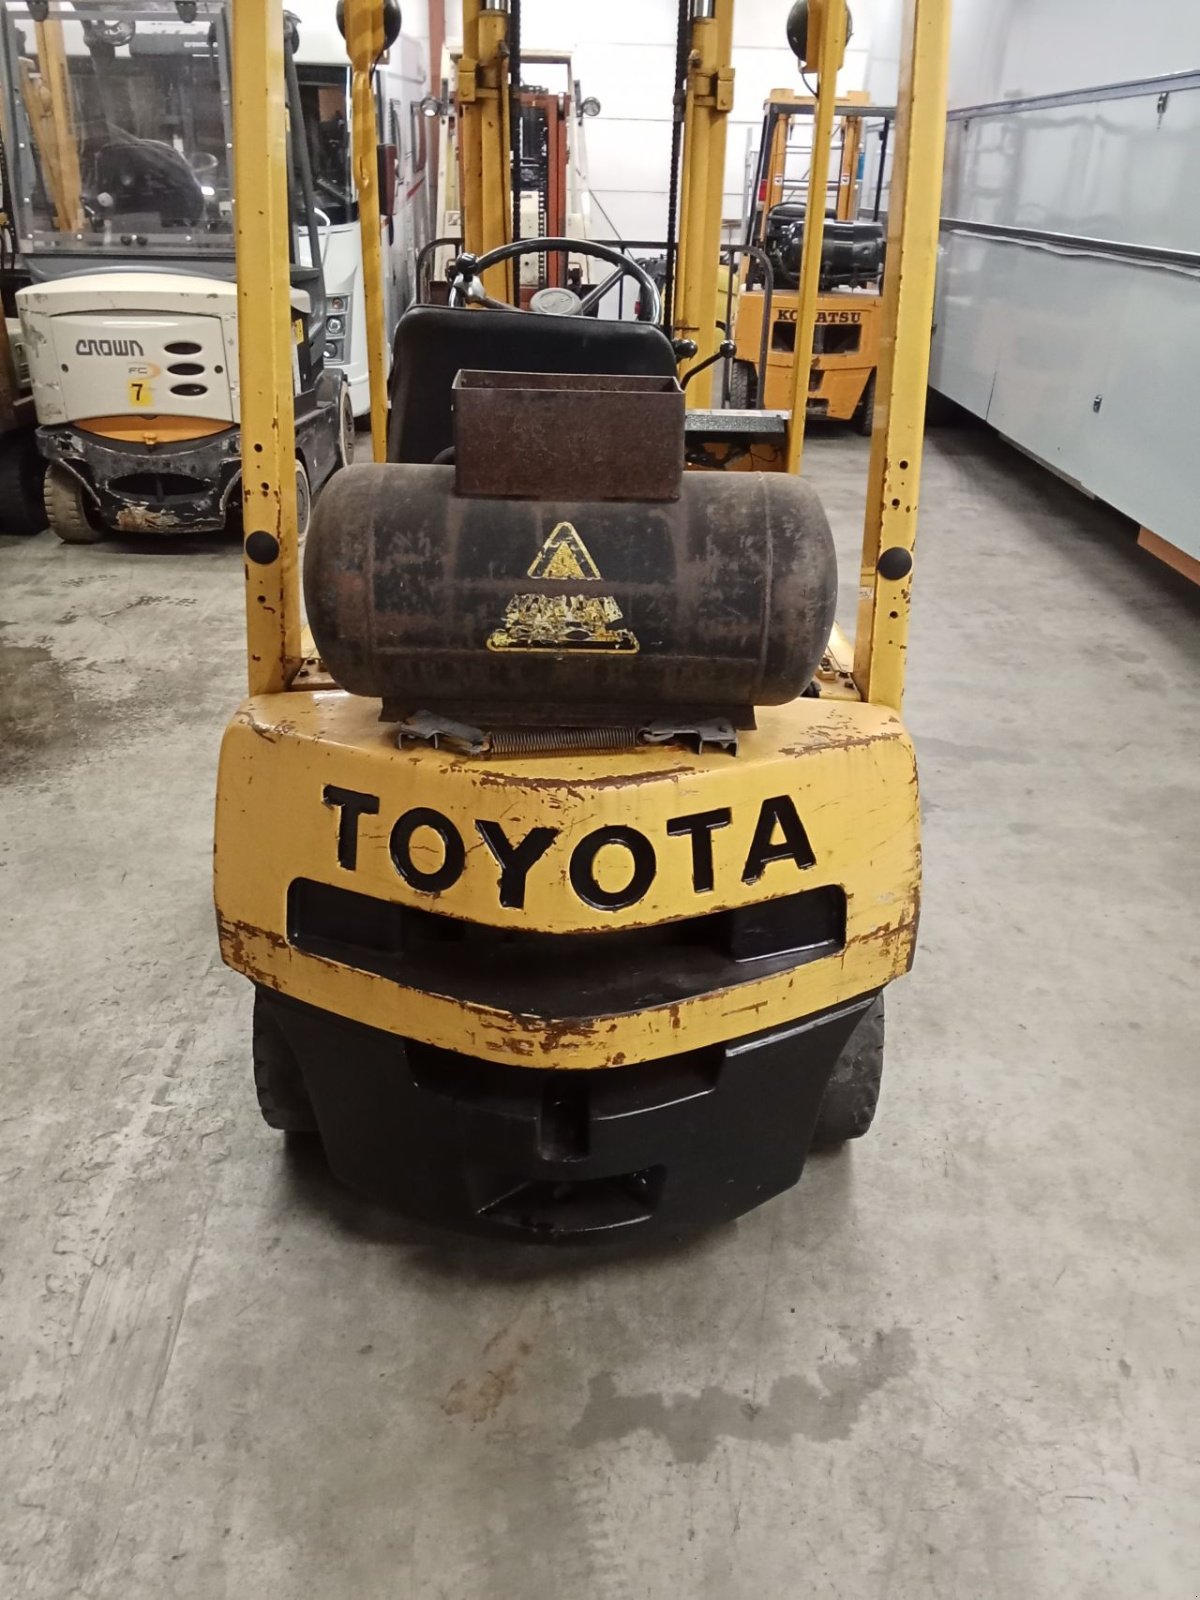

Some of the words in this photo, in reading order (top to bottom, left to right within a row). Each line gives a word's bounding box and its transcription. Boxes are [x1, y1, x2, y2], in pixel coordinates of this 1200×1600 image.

[777, 309, 862, 324] KOATSU
[76, 339, 144, 356] CROWN
[131, 383, 143, 401] 7
[322, 784, 818, 912] TOYOTA
